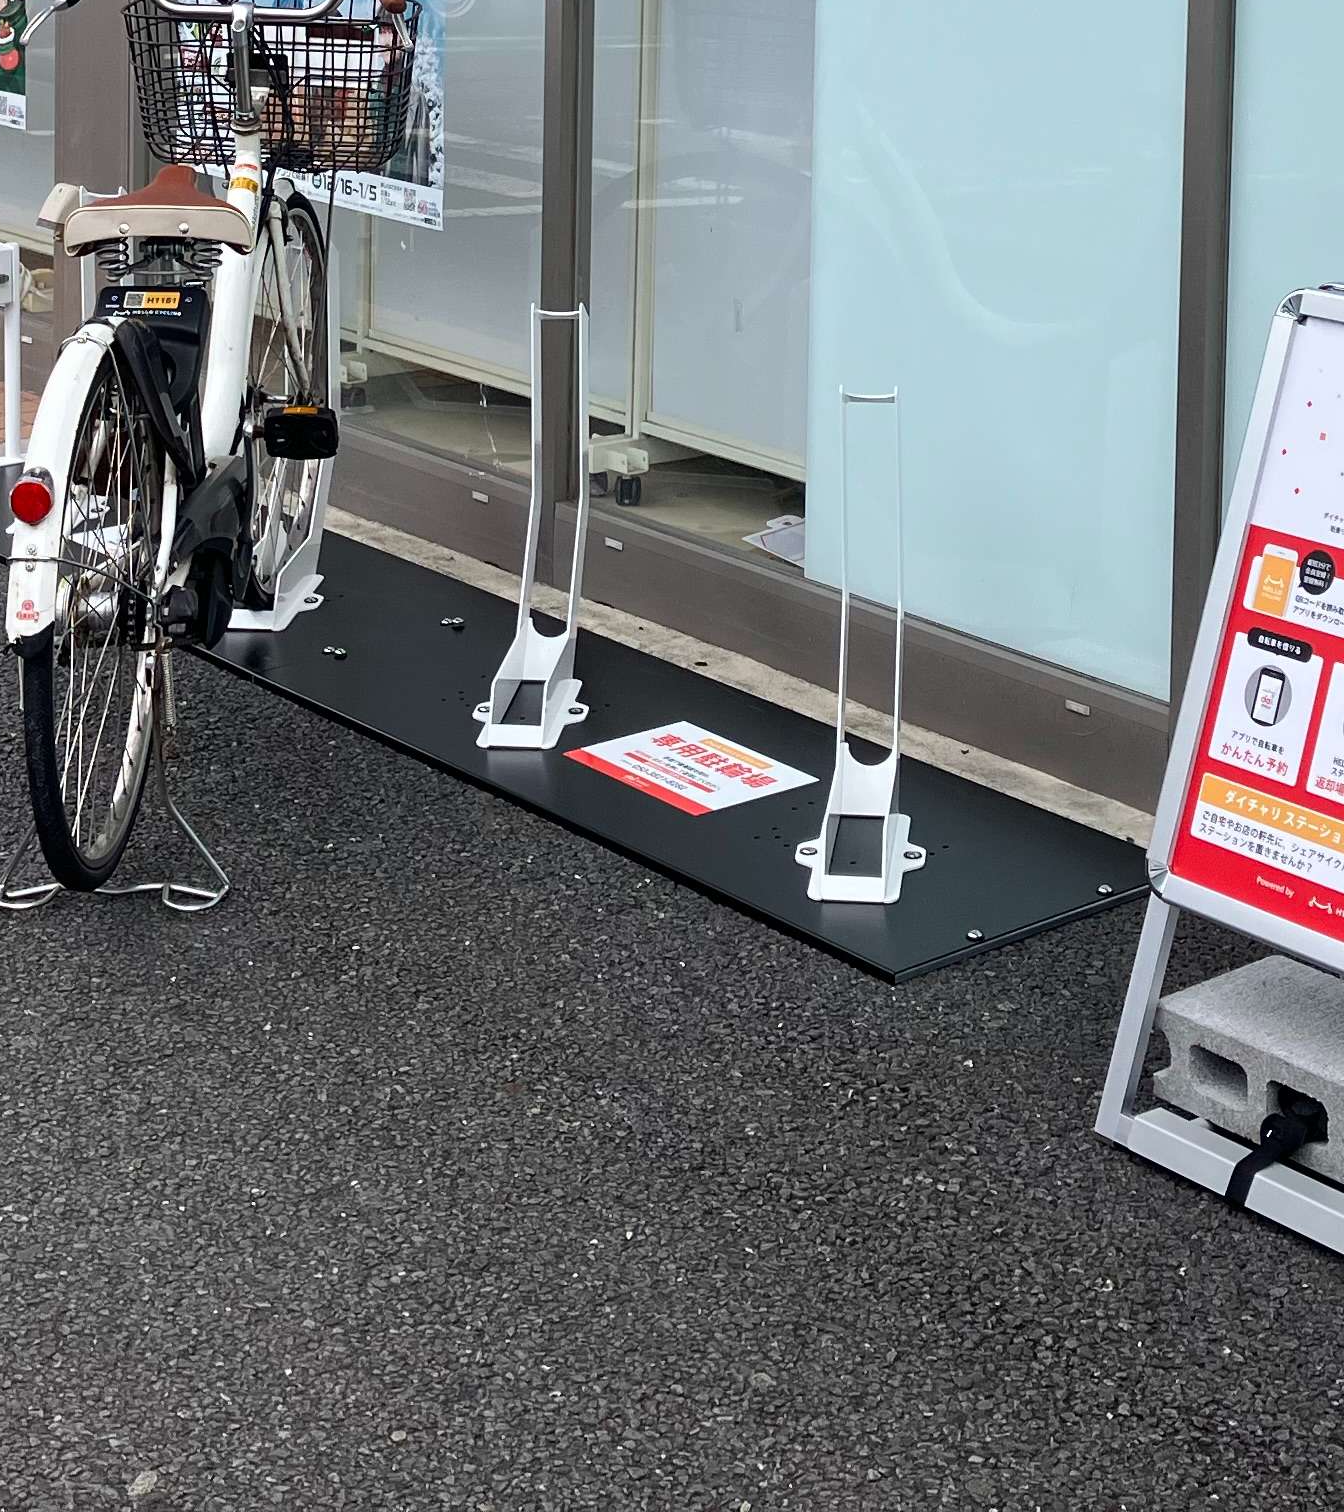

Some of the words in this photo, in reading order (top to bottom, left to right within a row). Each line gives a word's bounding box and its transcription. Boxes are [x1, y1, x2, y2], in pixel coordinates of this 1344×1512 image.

[1258, 634, 1302, 655] 自転車を借りる
[1231, 729, 1285, 755] アプリで自転車を
[1221, 742, 1289, 777] かんたん予約
[1224, 790, 1281, 819] ダイチャリ
[1256, 875, 1285, 896] Powered
[1285, 885, 1296, 899] by
